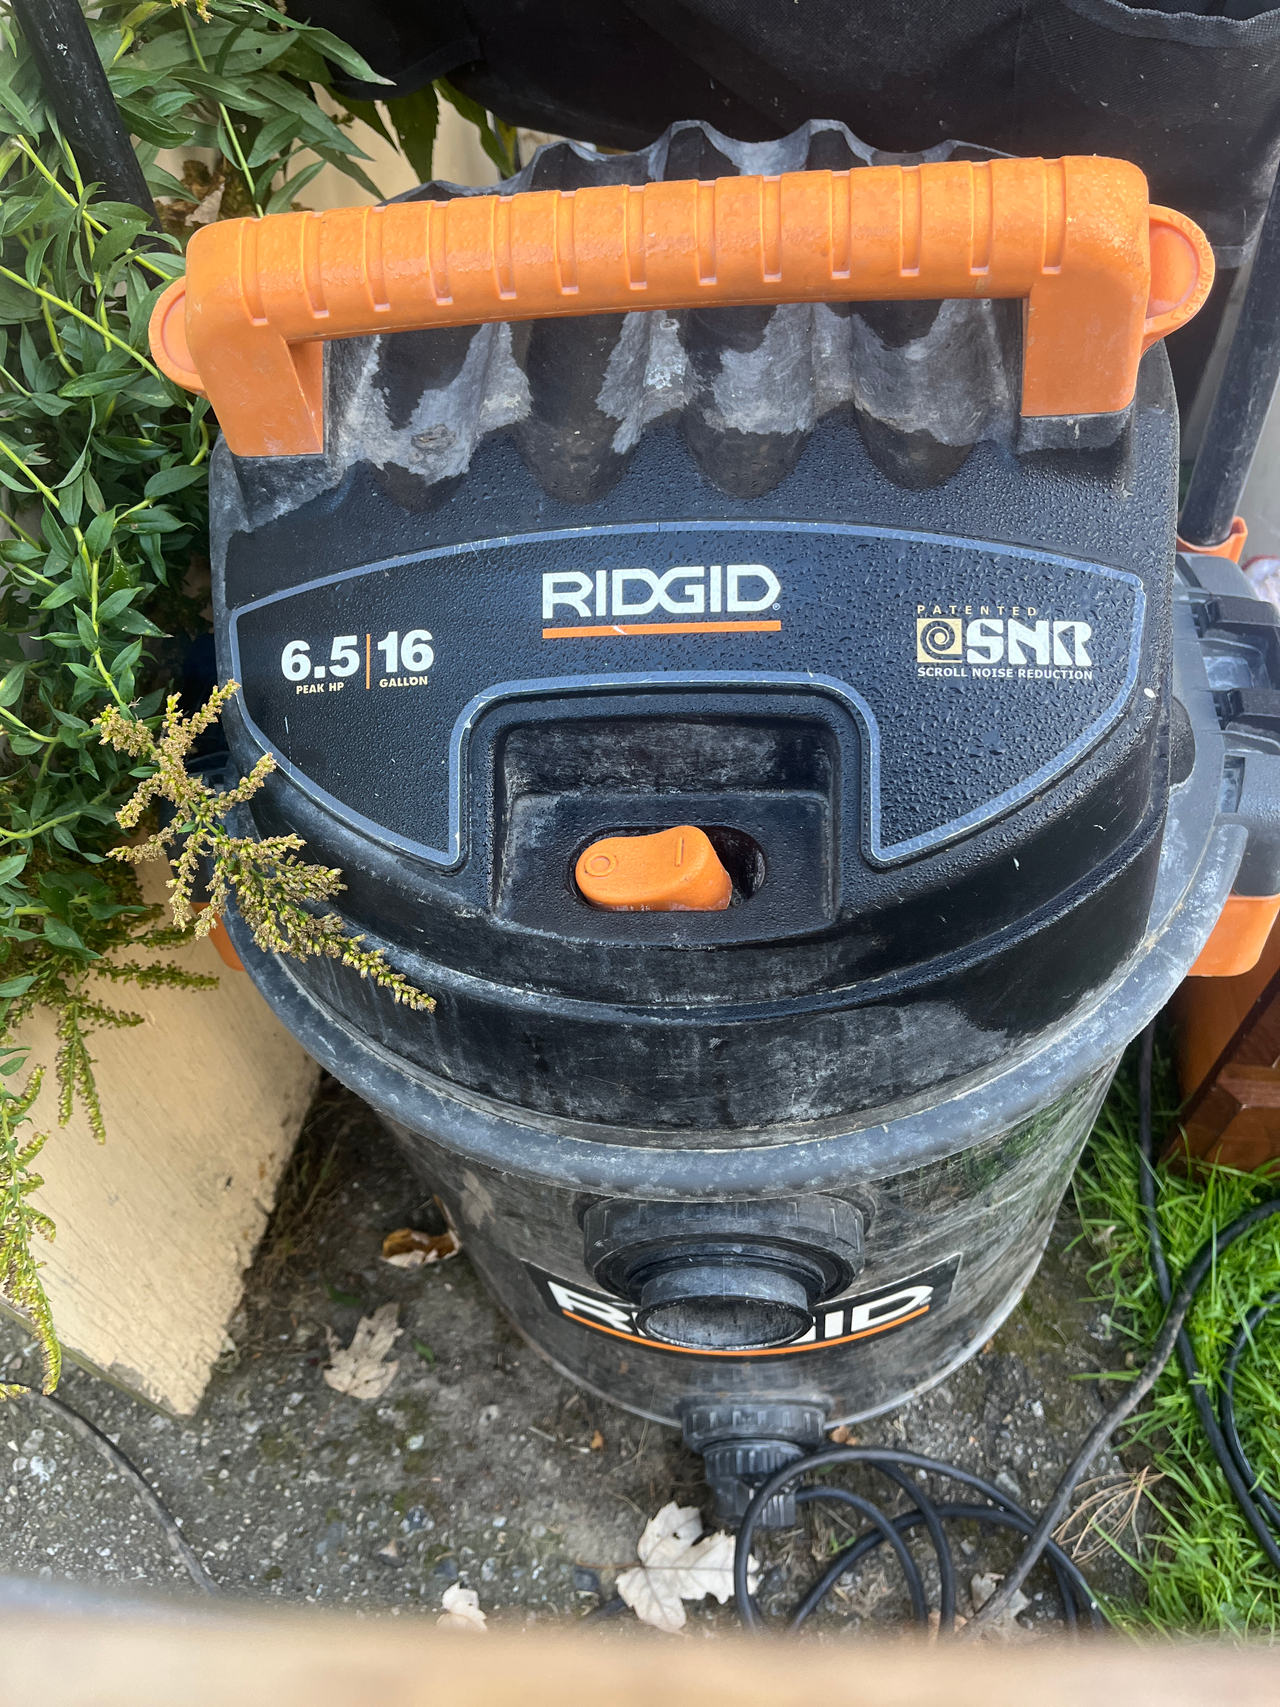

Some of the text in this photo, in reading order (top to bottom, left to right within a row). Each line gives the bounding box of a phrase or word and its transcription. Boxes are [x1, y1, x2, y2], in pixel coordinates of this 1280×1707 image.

[542, 564, 782, 619] RIDGID
[917, 605, 1037, 616] PATENTED
[281, 629, 434, 681] 6.5 16
[966, 618, 1092, 667] SNR
[296, 682, 345, 694] PEAK HP
[379, 676, 428, 688] GALLON
[917, 667, 1093, 680] SCROLL NOISE REDUCTION
[547, 1281, 934, 1345] RID
